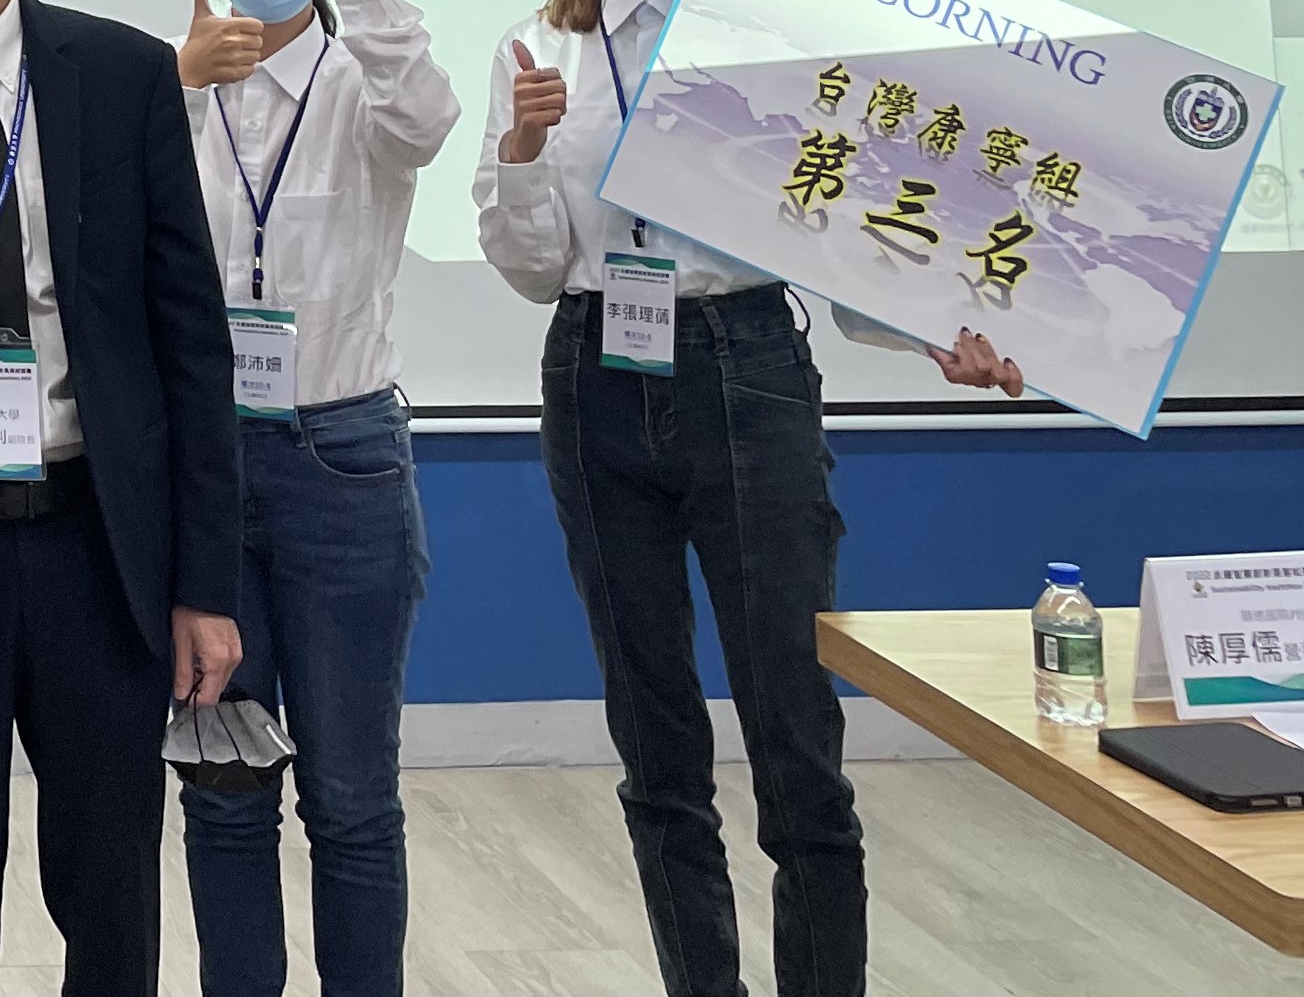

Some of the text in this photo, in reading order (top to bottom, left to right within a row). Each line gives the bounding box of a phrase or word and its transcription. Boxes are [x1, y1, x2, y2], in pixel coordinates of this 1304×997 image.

[818, 61, 1081, 198] 台灣康寧組
[781, 128, 1034, 285] 第三名
